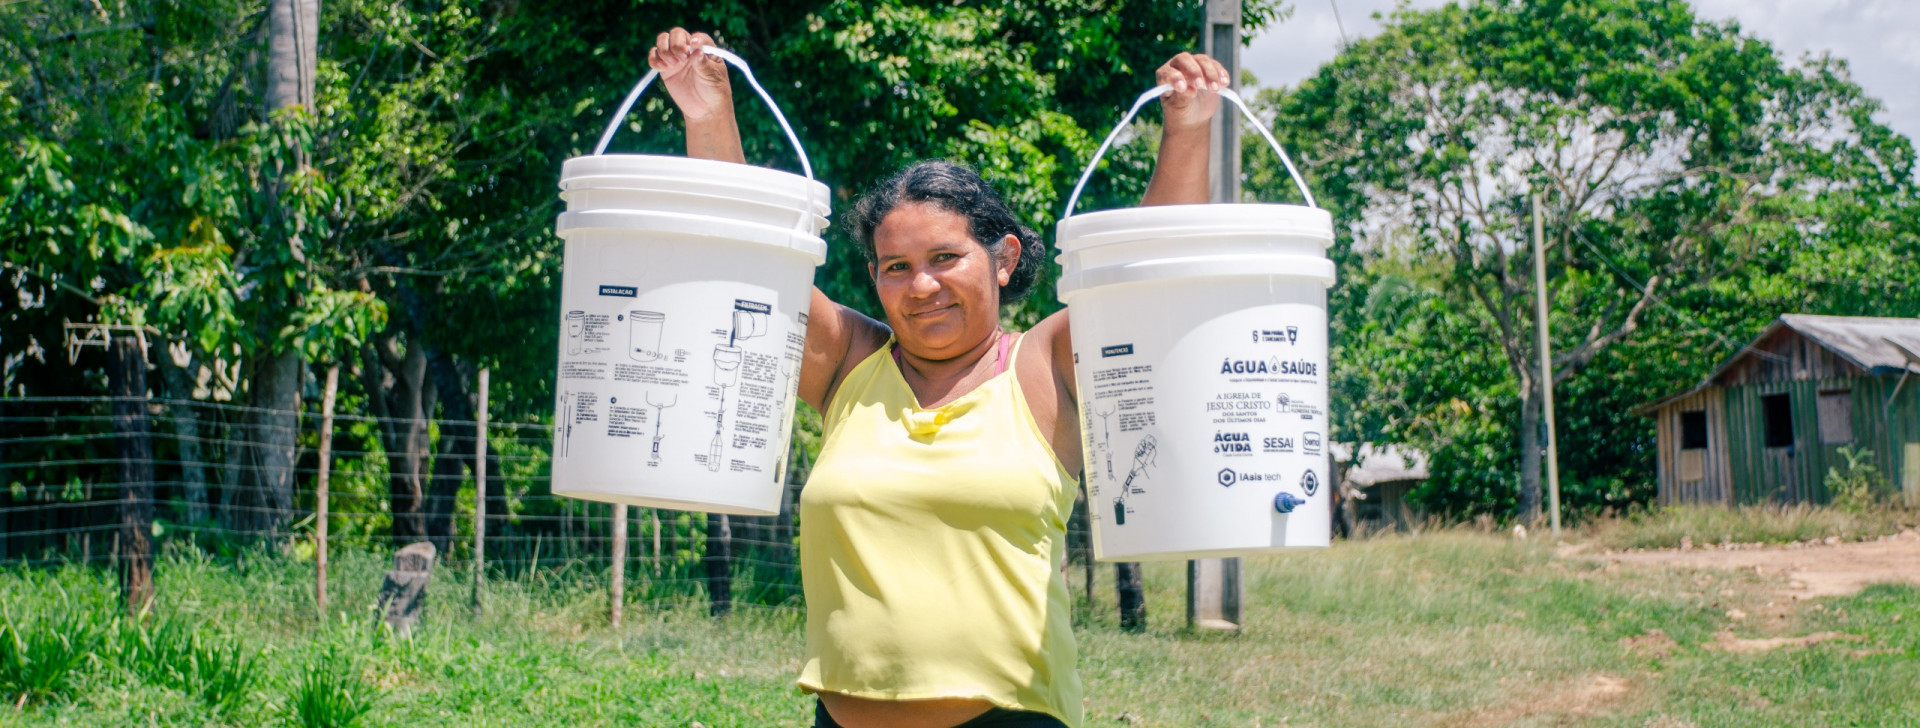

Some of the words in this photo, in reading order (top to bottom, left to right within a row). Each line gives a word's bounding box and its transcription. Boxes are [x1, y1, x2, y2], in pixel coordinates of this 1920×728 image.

[1220, 357, 1268, 374] ÁGUA
[1281, 358, 1317, 376] SAÚDE
[1206, 402, 1234, 412] JESUS
[1235, 400, 1271, 410] CRISTO
[1214, 430, 1250, 442] ÁGUA
[1220, 443, 1252, 452] VIDA
[1263, 437, 1294, 448] SESAI
[1264, 473, 1281, 481] tech
